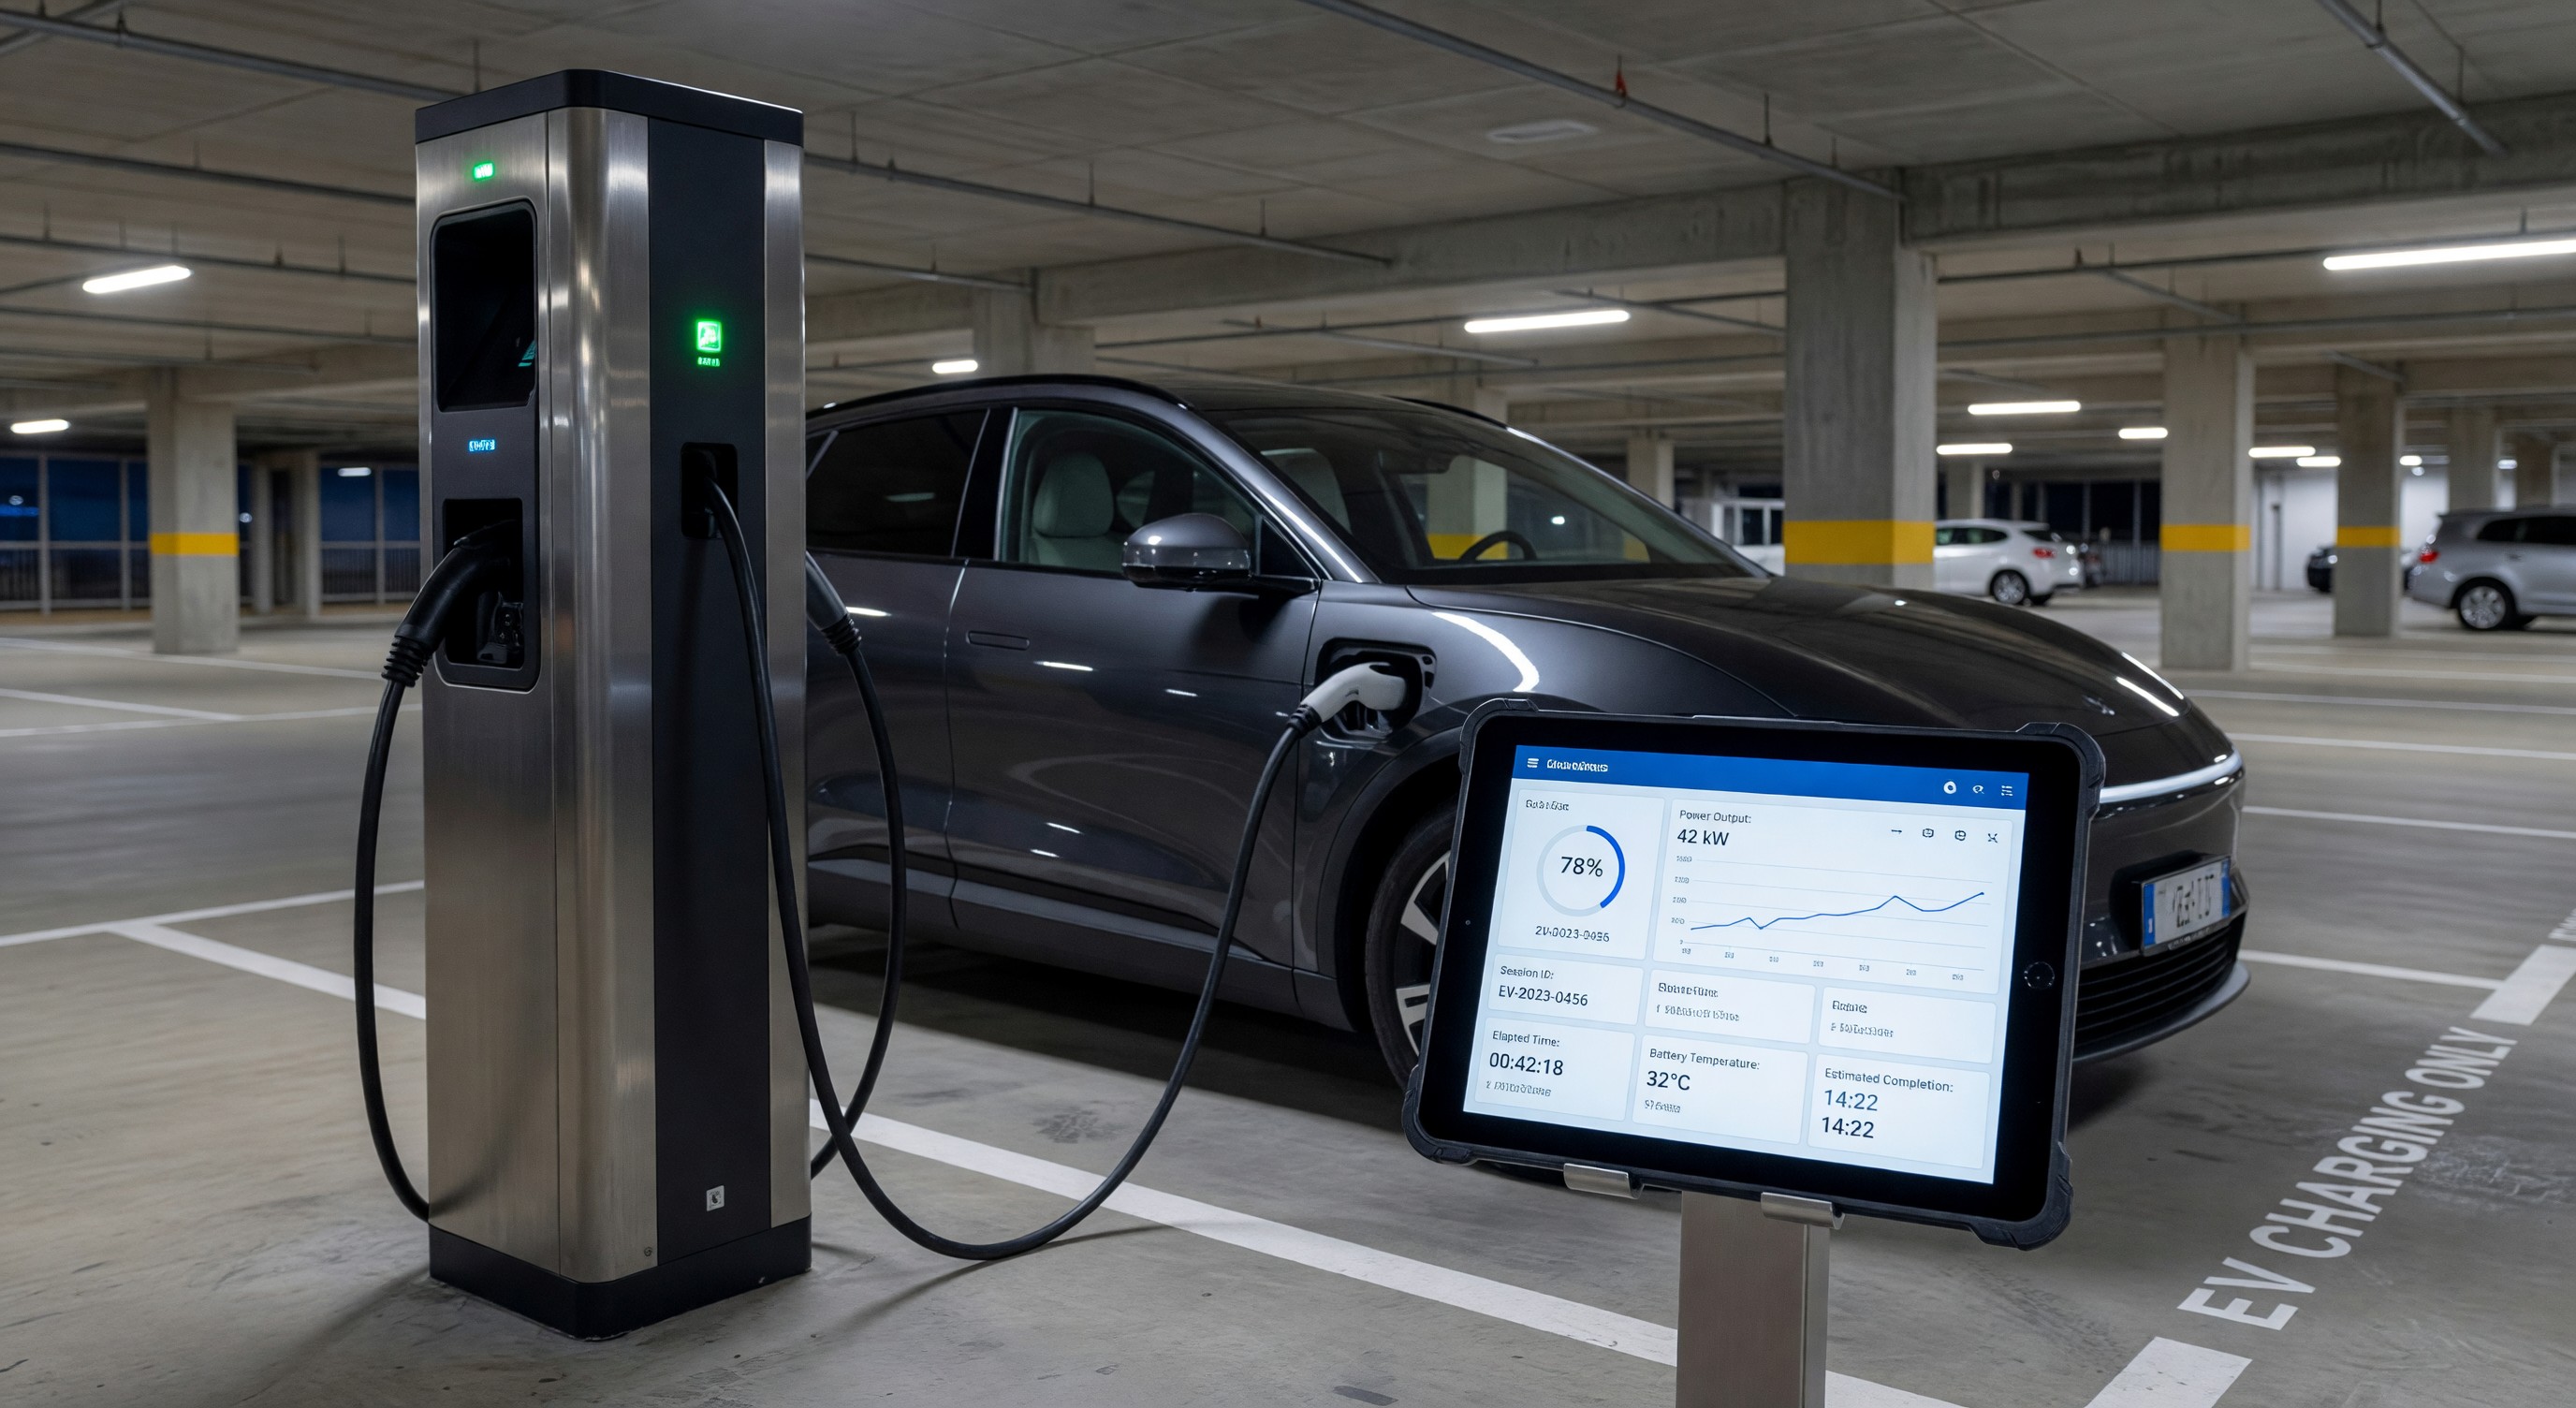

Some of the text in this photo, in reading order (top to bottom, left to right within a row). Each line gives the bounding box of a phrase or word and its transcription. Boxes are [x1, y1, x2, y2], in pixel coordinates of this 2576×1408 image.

[1679, 810, 1752, 824] Power Output:
[1676, 829, 1730, 846] 42 kW
[1560, 856, 1603, 877] 78%
[1541, 970, 1554, 979] ID:
[1498, 985, 1588, 1006] EV-2023-0456
[1532, 1034, 1560, 1048] Time:
[1489, 1052, 1564, 1076] 00:42:18
[1649, 1048, 1761, 1070] Battery Temperature:
[1647, 1070, 1691, 1092] 32°C
[1824, 1067, 1954, 1093] Estimated Completion:
[1824, 1089, 1879, 1112] 14:22
[1822, 1116, 1875, 1139] 14:22
[2176, 1026, 2518, 1330] EV CHARGING ONLY
